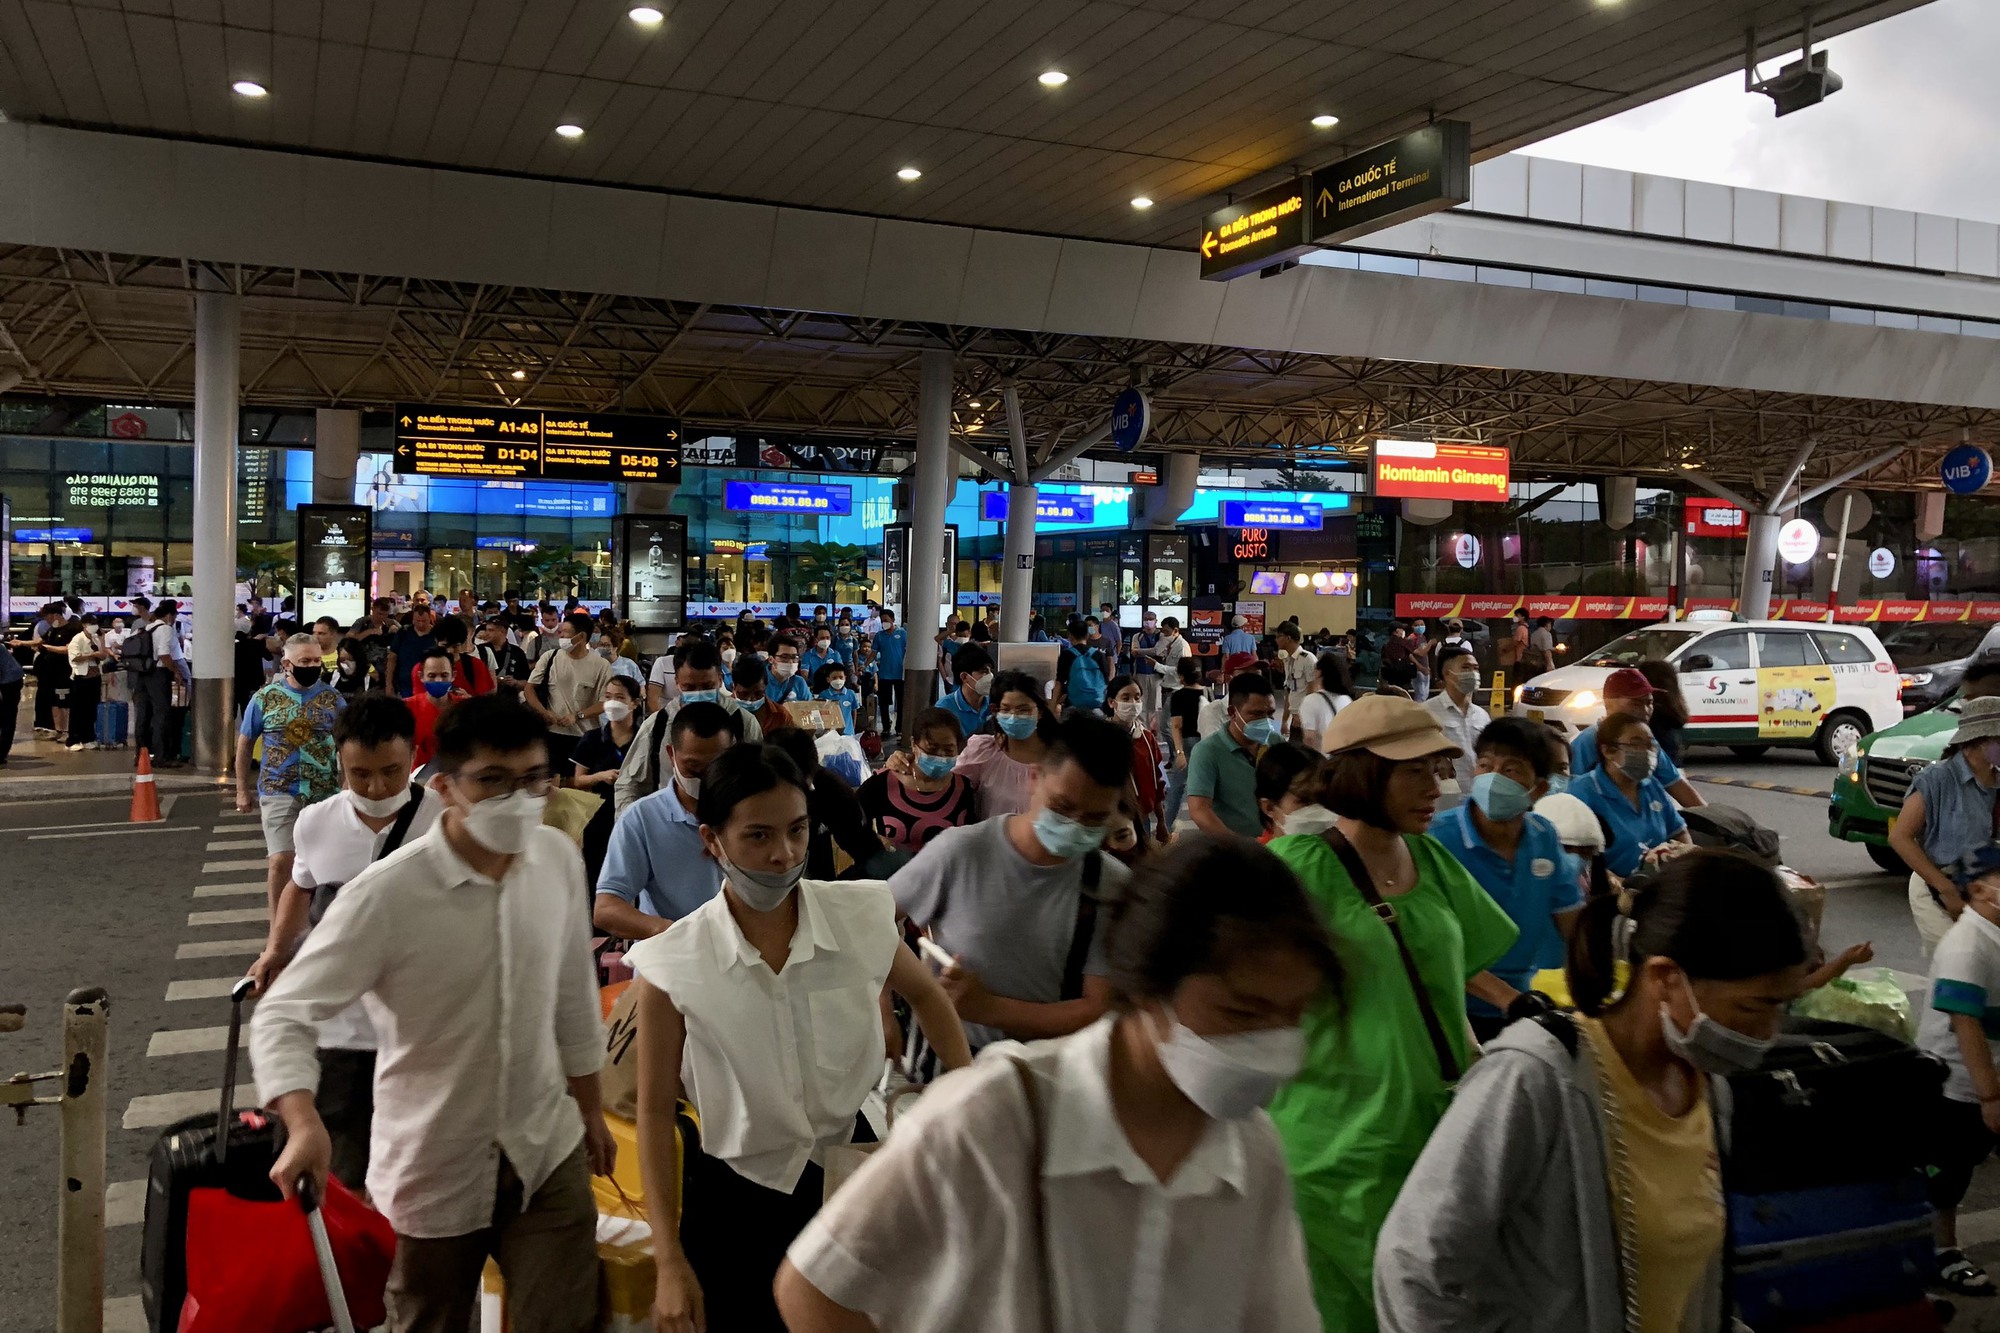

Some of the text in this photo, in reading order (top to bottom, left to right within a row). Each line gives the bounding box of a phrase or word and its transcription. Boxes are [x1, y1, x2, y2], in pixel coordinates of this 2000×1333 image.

[1338, 156, 1397, 194] GA QUỐC TẾ
[1338, 169, 1430, 212] International Terminal
[1220, 224, 1232, 238] GA
[1250, 206, 1277, 226] TRONG
[1220, 225, 1277, 254] Domestic Arrivals
[417, 415, 429, 423] GA
[446, 417, 473, 425] TRONG
[1112, 413, 1129, 431] VIB
[499, 421, 538, 434] A1-A3
[415, 442, 427, 450] GA
[437, 443, 463, 451] TRONG
[415, 450, 484, 460] Domestic Departures
[498, 448, 538, 460] D1-D4
[545, 456, 610, 466] Domestic Departures
[621, 455, 659, 467] D5-D8
[1379, 463, 1506, 489] Homtamin Ginseng
[1945, 465, 1971, 480] VIB
[1242, 528, 1268, 542] PURO
[1234, 543, 1268, 558] GUSTO
